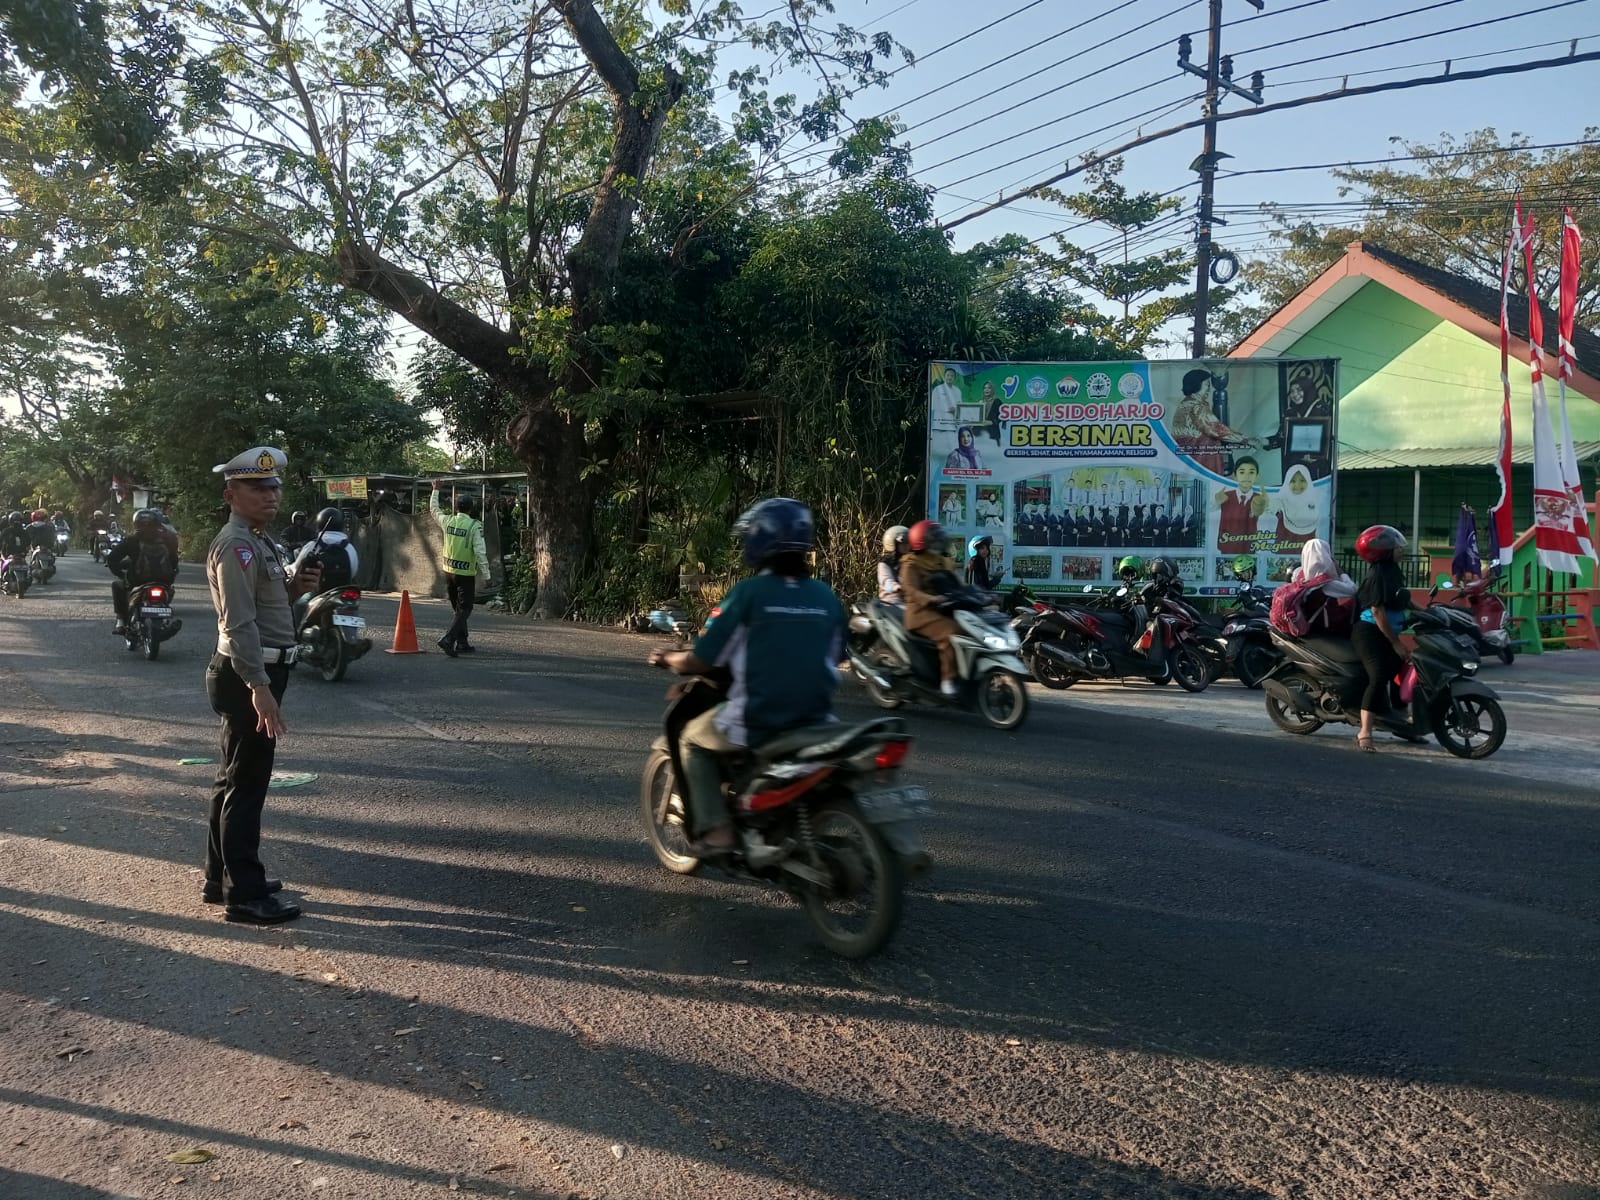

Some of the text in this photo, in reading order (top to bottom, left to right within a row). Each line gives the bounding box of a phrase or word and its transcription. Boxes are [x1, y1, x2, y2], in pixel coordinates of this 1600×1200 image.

[1000, 402, 1165, 420] SDN 1 SIDOHARJO
[1011, 425, 1152, 446] BERSINAR
[1126, 449, 1155, 457] RELIGIUS
[1219, 529, 1278, 544] Semakin
